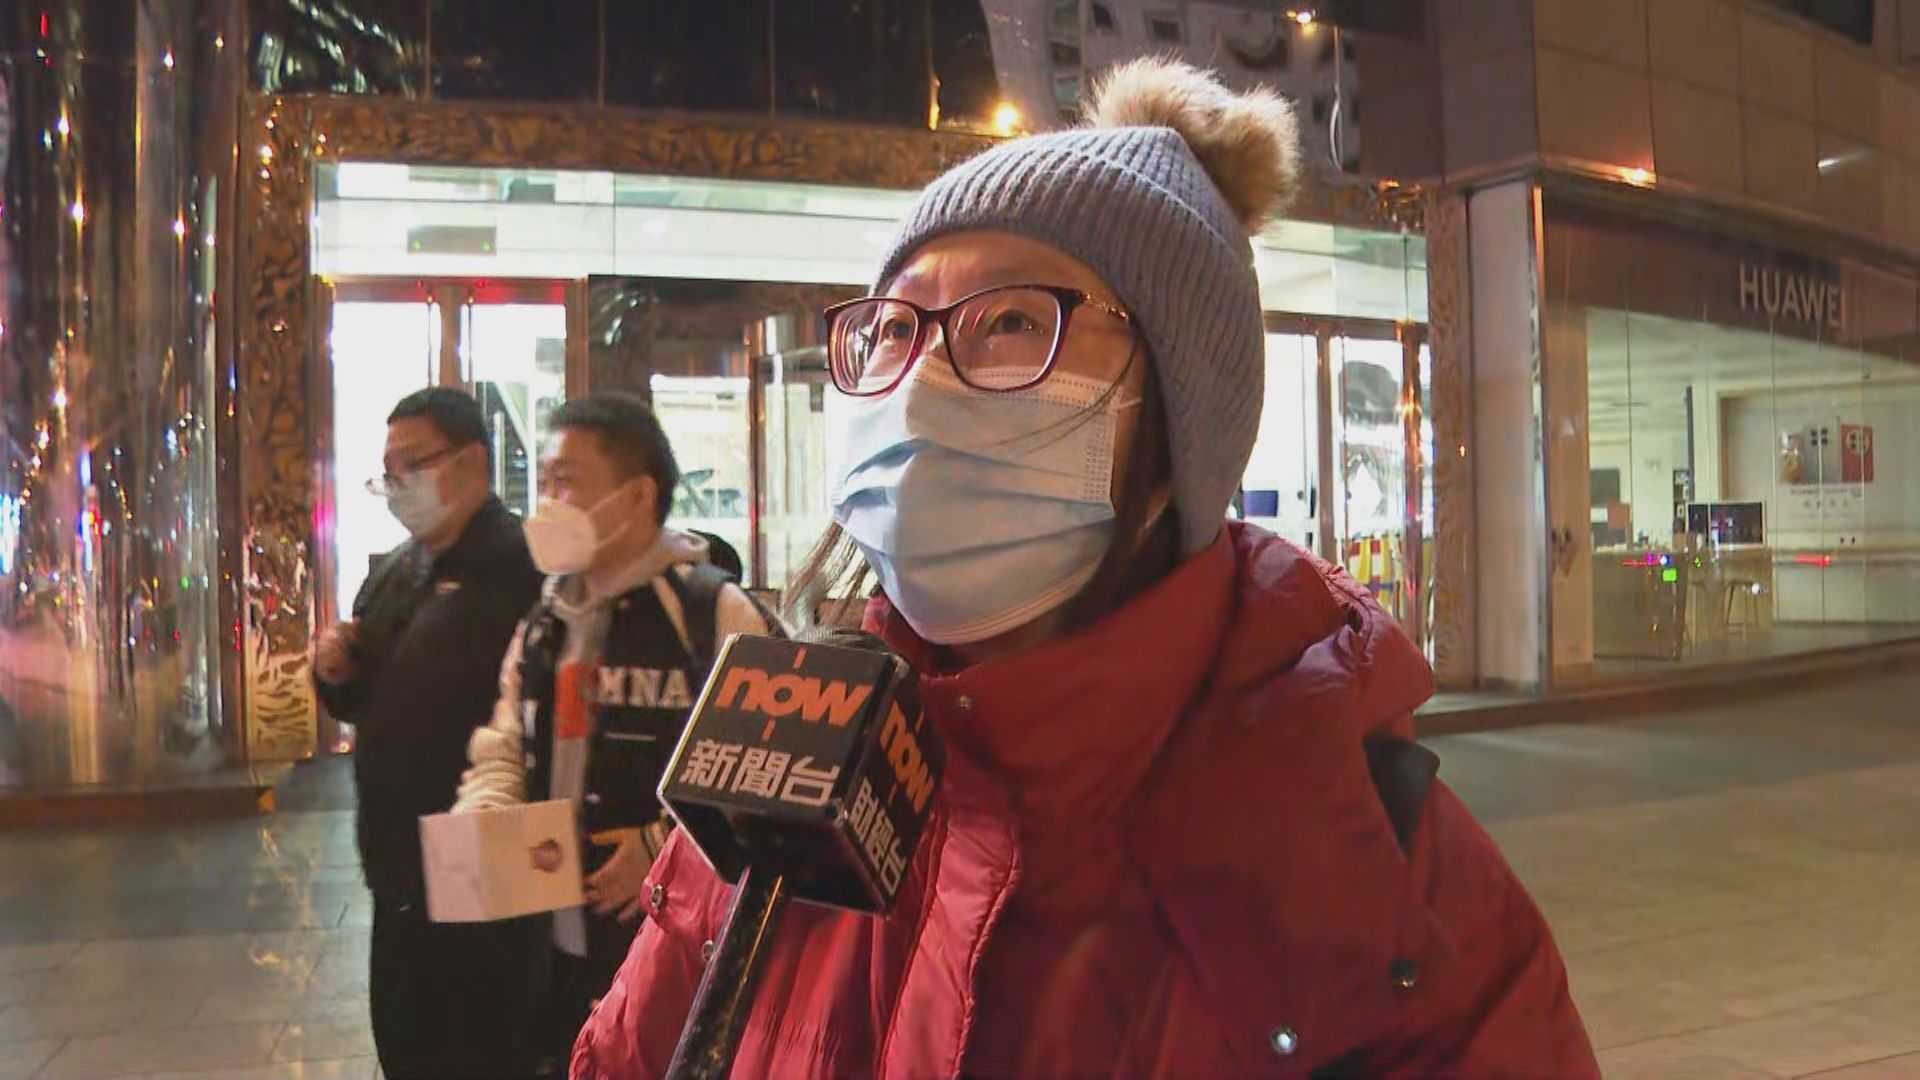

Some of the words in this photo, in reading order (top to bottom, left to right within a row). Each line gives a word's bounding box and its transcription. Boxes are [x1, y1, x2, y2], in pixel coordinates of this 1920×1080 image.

[715, 666, 874, 726] now
[679, 739, 840, 806] 新聞台
[880, 699, 934, 814] now
[849, 776, 906, 896] 財經台
